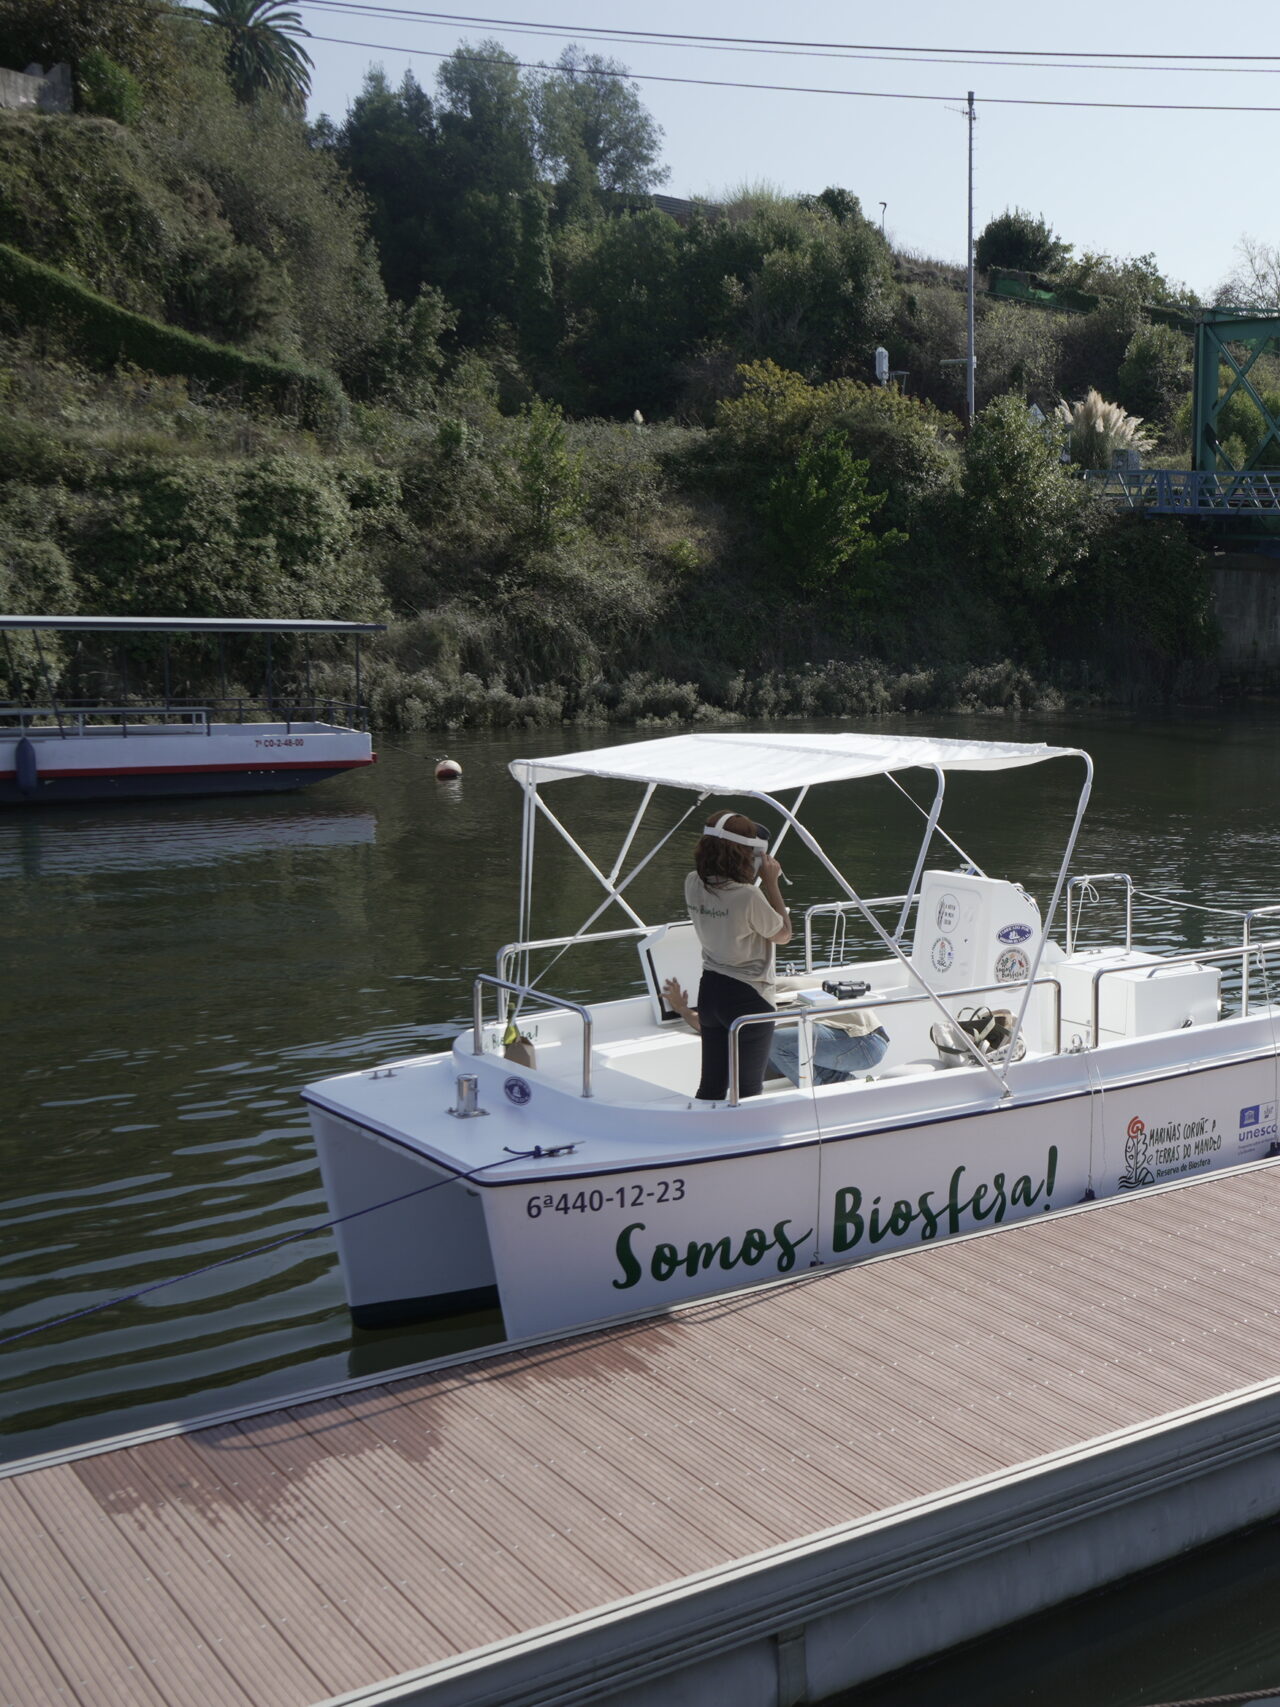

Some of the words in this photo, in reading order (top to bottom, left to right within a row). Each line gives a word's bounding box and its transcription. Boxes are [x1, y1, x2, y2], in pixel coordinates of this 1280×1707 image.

[1149, 1121, 1181, 1147] MARIÑAS
[1238, 1124, 1278, 1142] unesco
[1155, 1145, 1180, 1165] TERRAS
[1183, 1143, 1192, 1159] DO
[1194, 1134, 1222, 1155] MANDEO
[1156, 1165, 1179, 1178] Reserva
[1180, 1163, 1187, 1174] de
[1188, 1158, 1211, 1170] Biosfera
[526, 1178, 686, 1219] 6ª440-12-23
[612, 1219, 813, 1290] Somos
[832, 1145, 1058, 1253] Biosfera!
